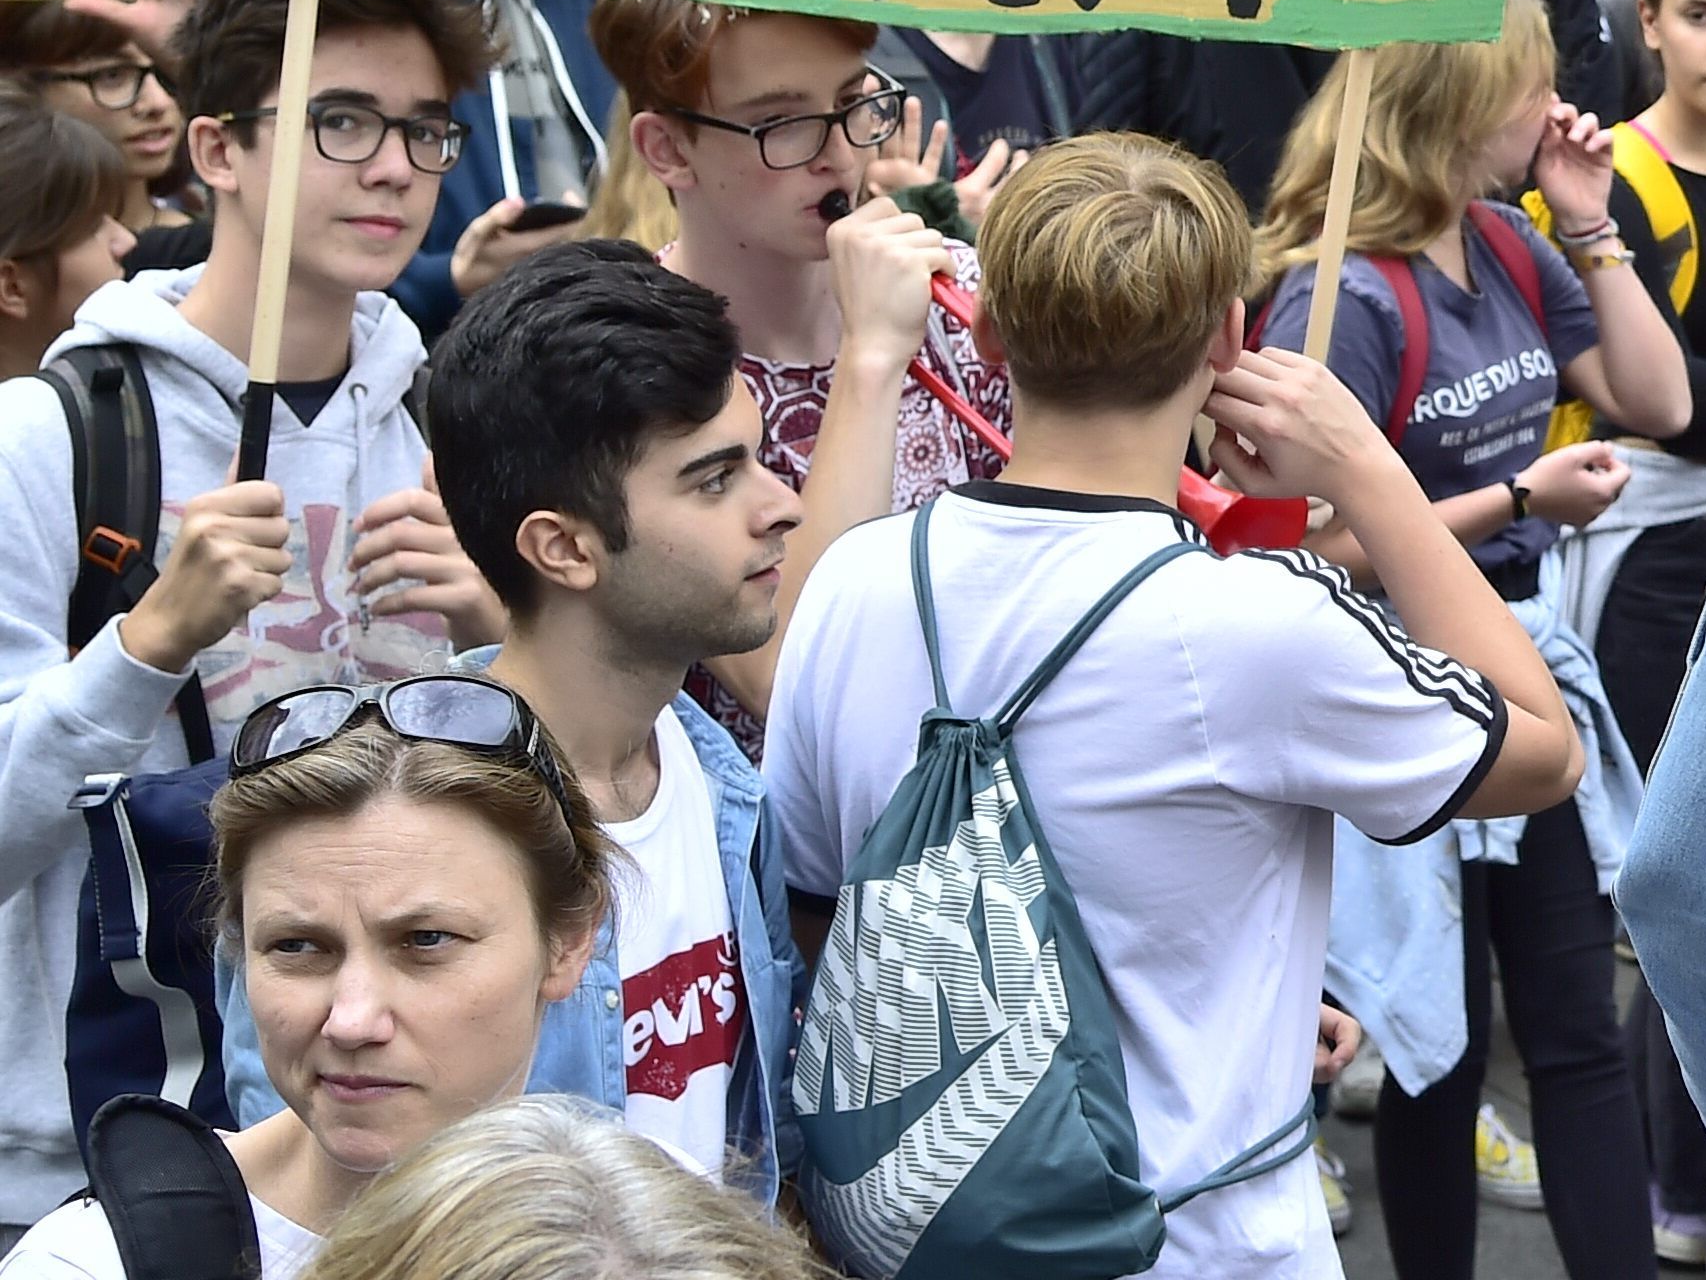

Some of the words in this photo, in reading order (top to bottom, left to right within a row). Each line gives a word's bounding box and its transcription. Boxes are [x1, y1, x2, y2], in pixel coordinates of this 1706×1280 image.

[1407, 372, 1493, 424] RQUE
[1485, 356, 1521, 393] DU
[1519, 347, 1557, 381] SO
